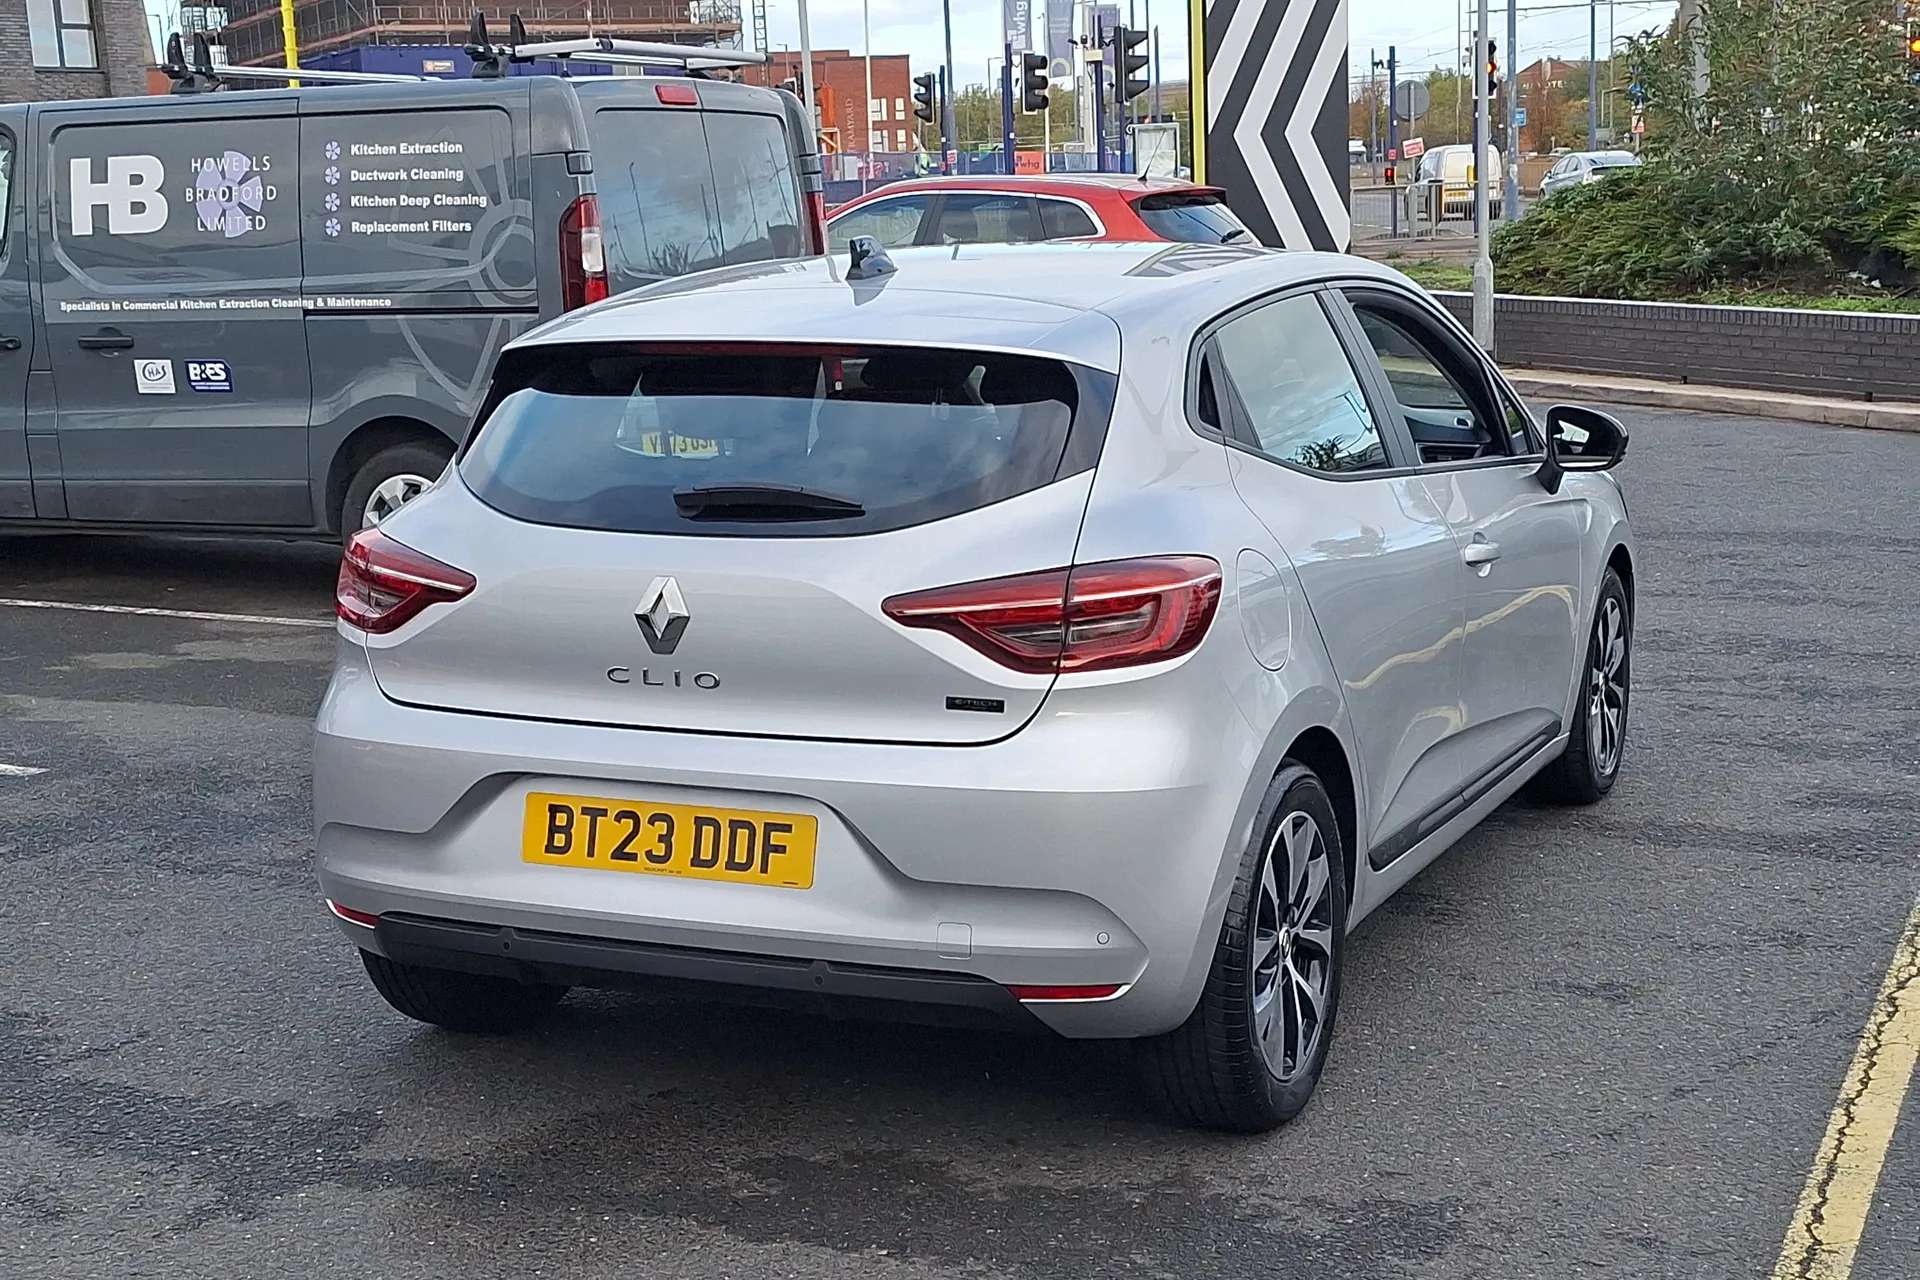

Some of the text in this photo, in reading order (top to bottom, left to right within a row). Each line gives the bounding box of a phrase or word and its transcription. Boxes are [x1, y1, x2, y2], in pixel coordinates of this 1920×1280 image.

[1013, 1, 1028, 34] whg
[350, 142, 463, 156] Kitchen Extraction
[191, 156, 271, 173] HOWELLS
[1020, 159, 1040, 169] whg
[350, 168, 464, 182] Ductwork Cleaning
[69, 154, 169, 236] HB
[185, 186, 277, 203] BRADFORD
[350, 194, 487, 208] Kitchen Deep Cleaning
[197, 216, 267, 232] LIMITED
[351, 220, 472, 235] Replacement Filters
[60, 301, 110, 312] Specialists
[122, 301, 178, 310] Commercial
[180, 300, 217, 310] Kitchen
[219, 299, 270, 309] Extraction
[271, 298, 314, 309] Cleaning
[316, 297, 325, 307] &
[327, 297, 392, 307] Maintenance
[142, 361, 167, 382] CHAS
[188, 363, 227, 381] B&ES
[606, 665, 721, 690] CLIO
[544, 804, 793, 875] BT23 DDF
